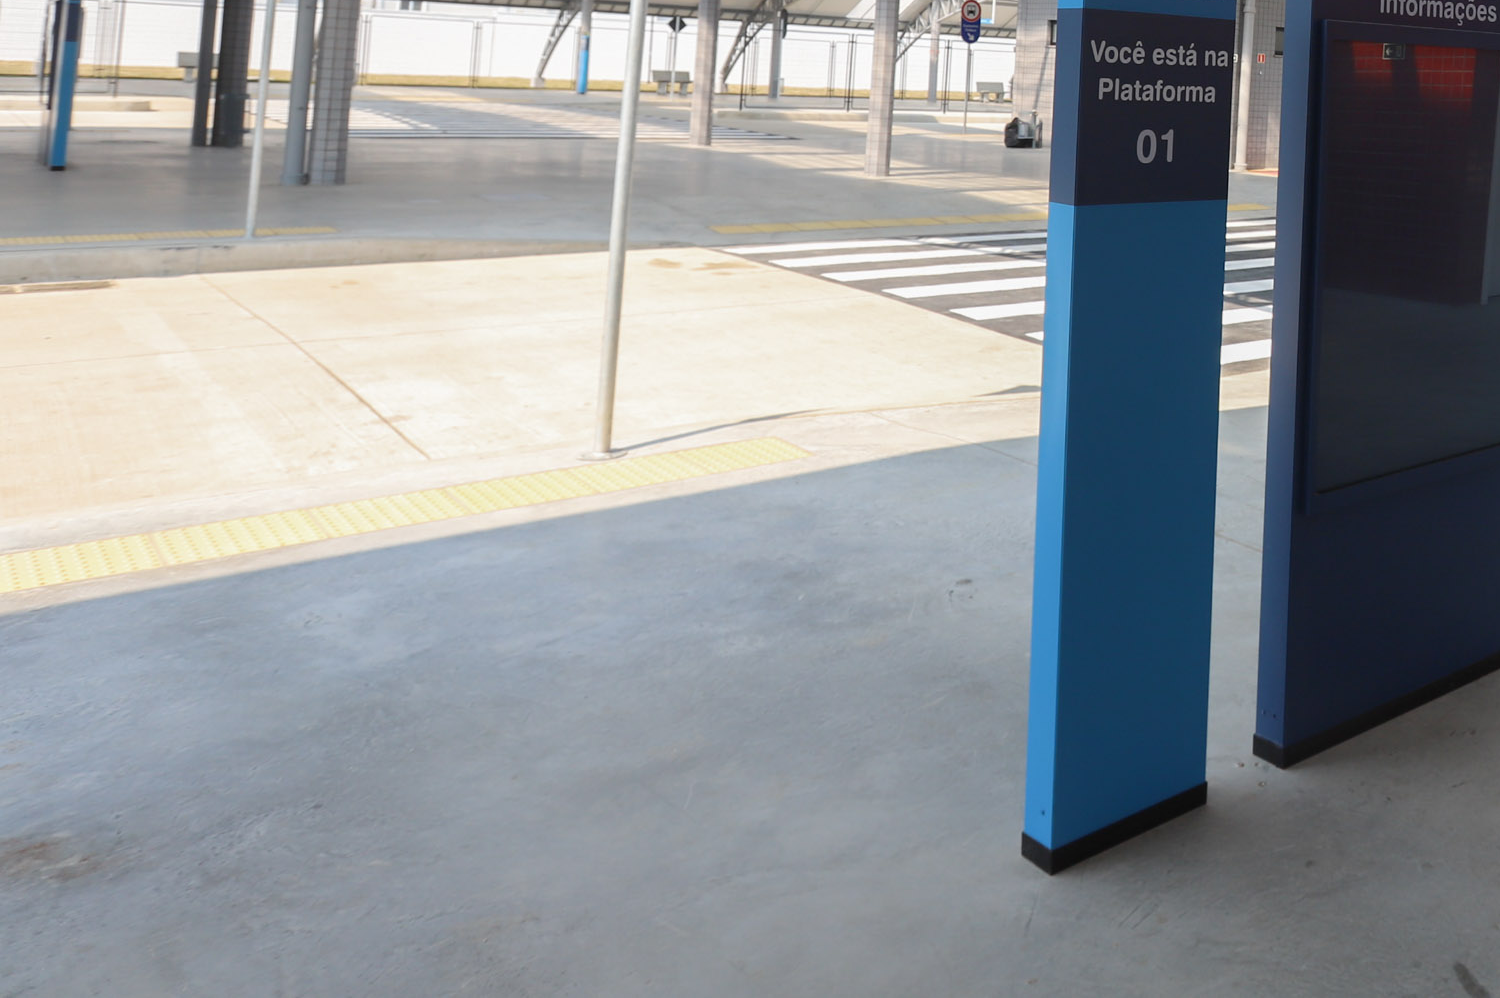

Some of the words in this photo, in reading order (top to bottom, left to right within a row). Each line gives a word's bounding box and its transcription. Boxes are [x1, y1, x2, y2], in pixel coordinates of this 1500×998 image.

[1090, 39, 1146, 65] Você
[1152, 43, 1197, 67] está
[1204, 49, 1228, 67] na
[1098, 77, 1216, 104] Plataforma
[1136, 128, 1175, 164] 01
